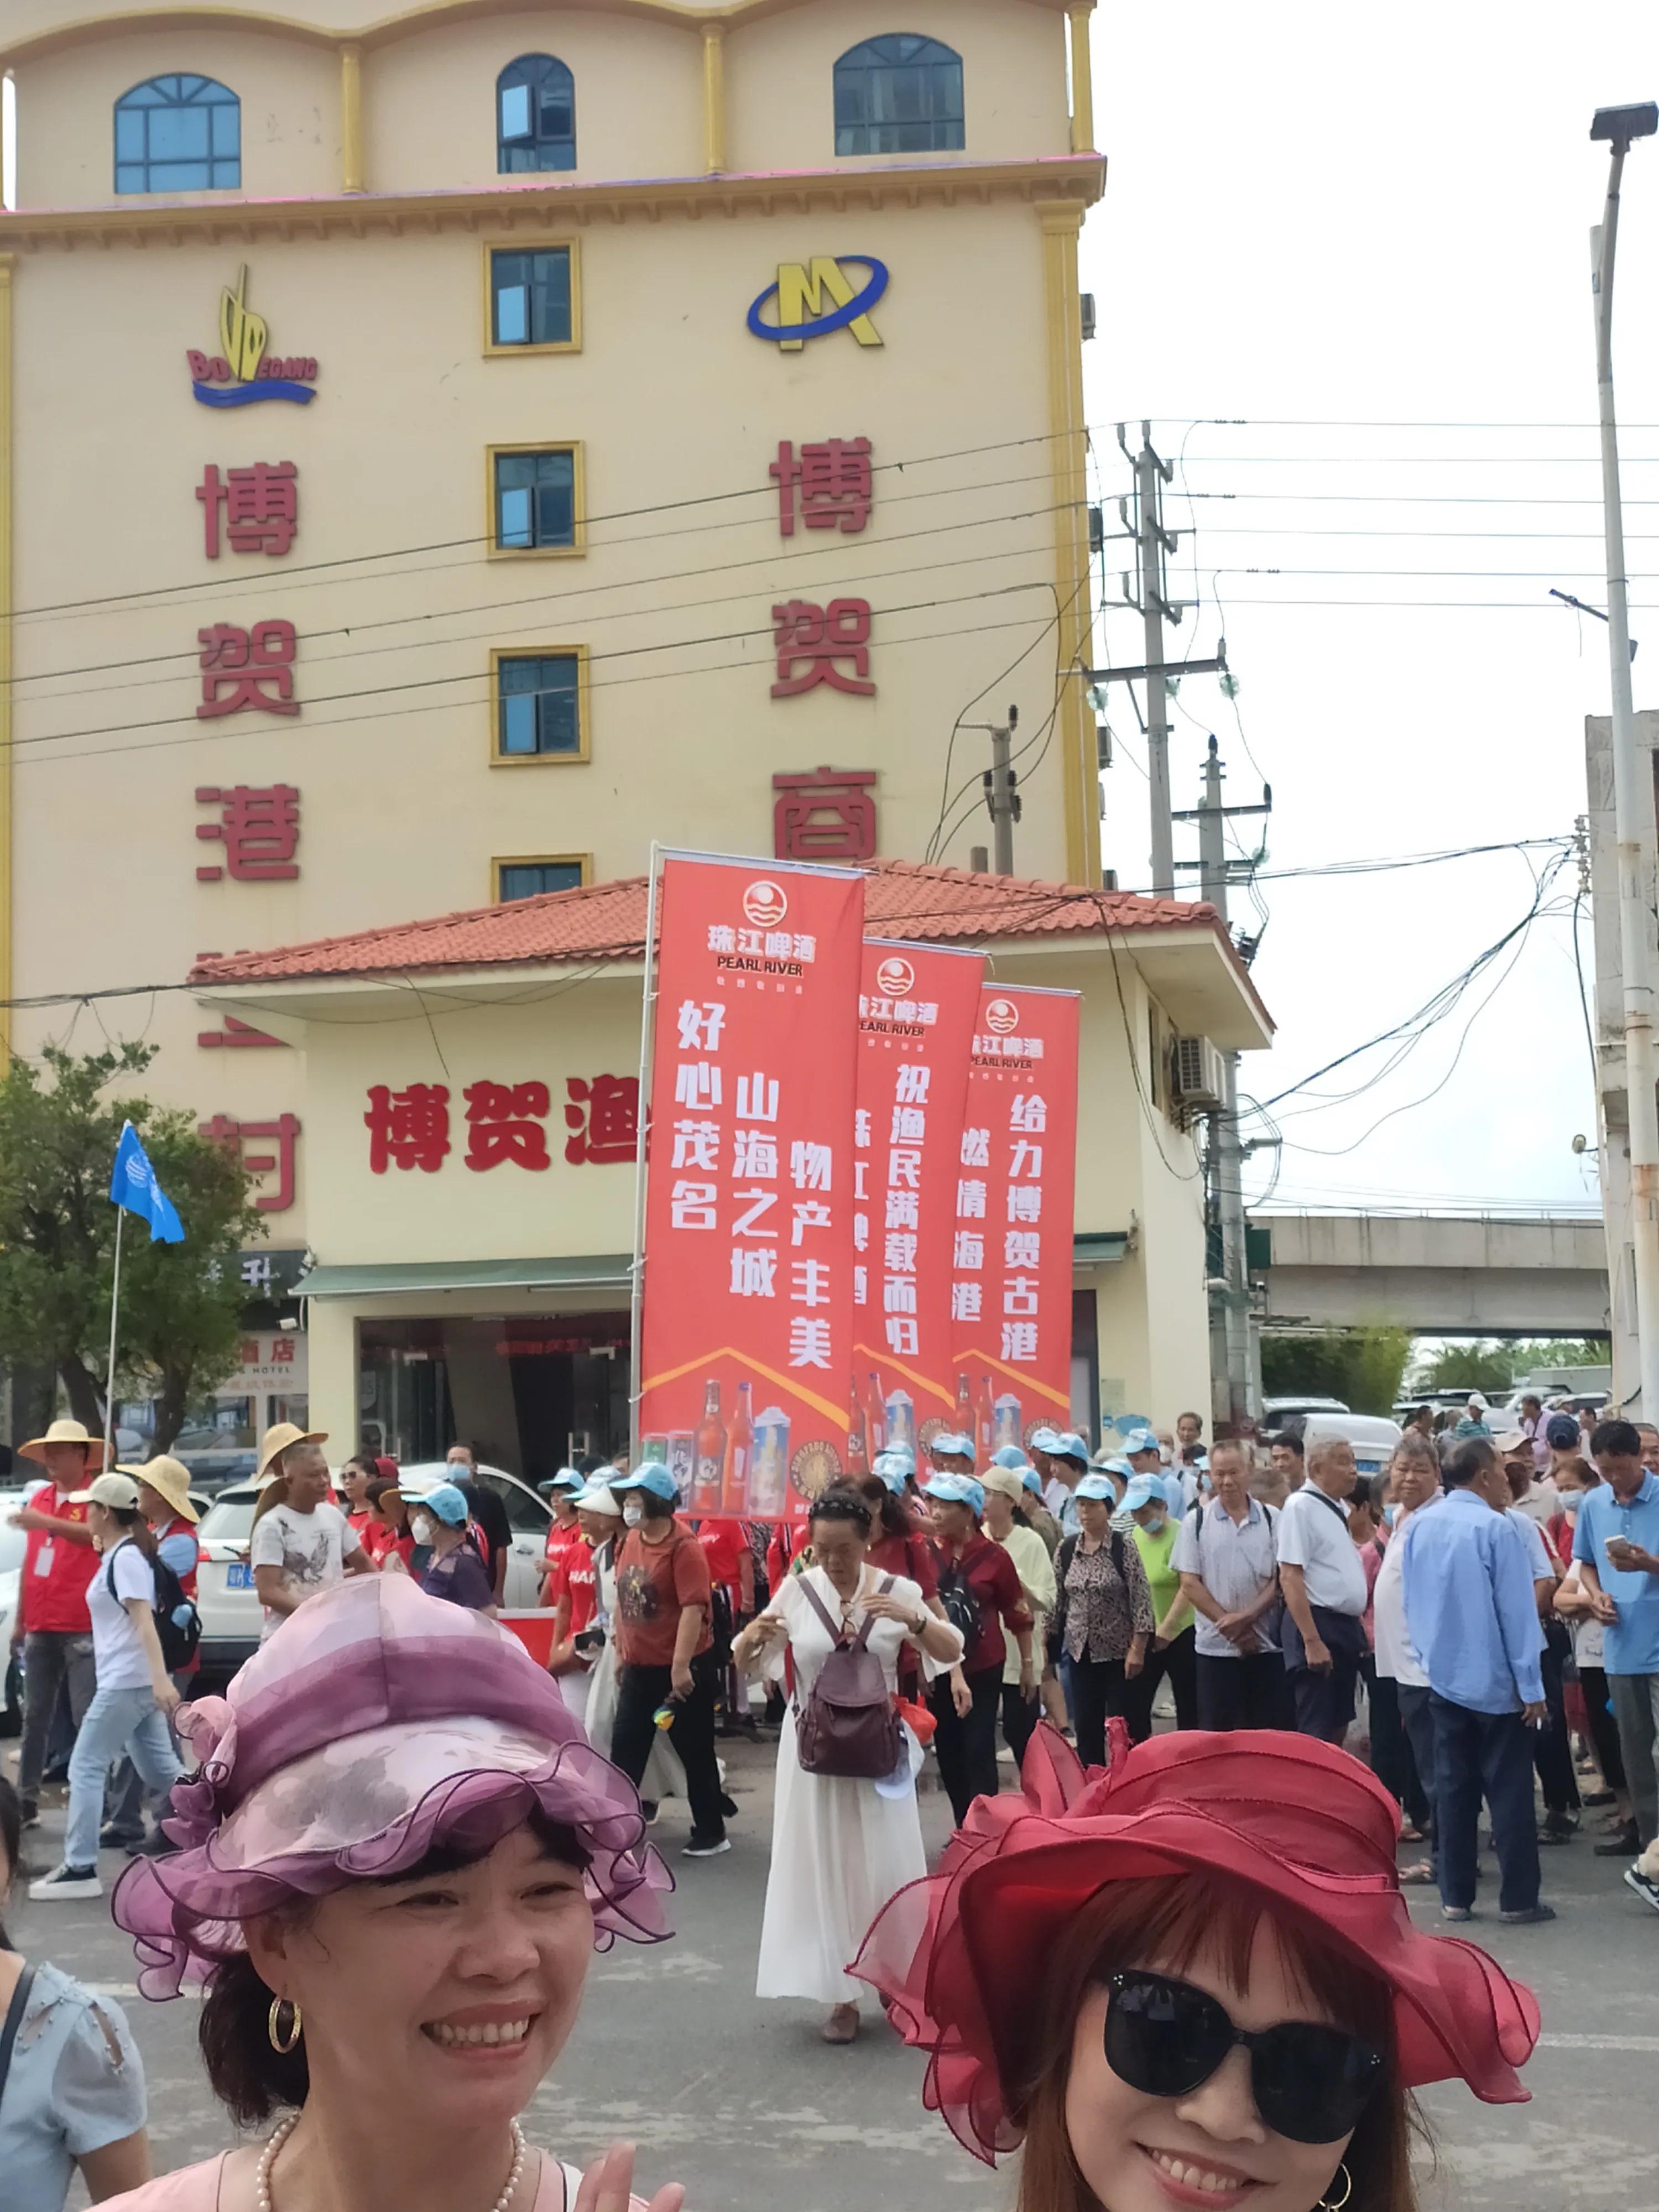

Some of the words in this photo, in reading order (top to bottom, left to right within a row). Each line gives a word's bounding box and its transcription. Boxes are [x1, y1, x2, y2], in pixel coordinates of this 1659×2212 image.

[707, 925, 817, 963] 珠江啤酒
[717, 956, 761, 972] PEARL
[764, 960, 803, 977] RIVER
[860, 1021, 890, 1034] EARL
[892, 1024, 925, 1036] RIVER
[1003, 1059, 1032, 1069] RIVER
[363, 1074, 649, 1174] 博贺渔
[671, 999, 726, 1230] 好心茂名
[729, 1072, 780, 1297] 山海之城
[789, 1140, 833, 1369] 物产丰美
[883, 1064, 931, 1355] 祝渔民满载而归
[1000, 1094, 1047, 1361] 给力博贺古港
